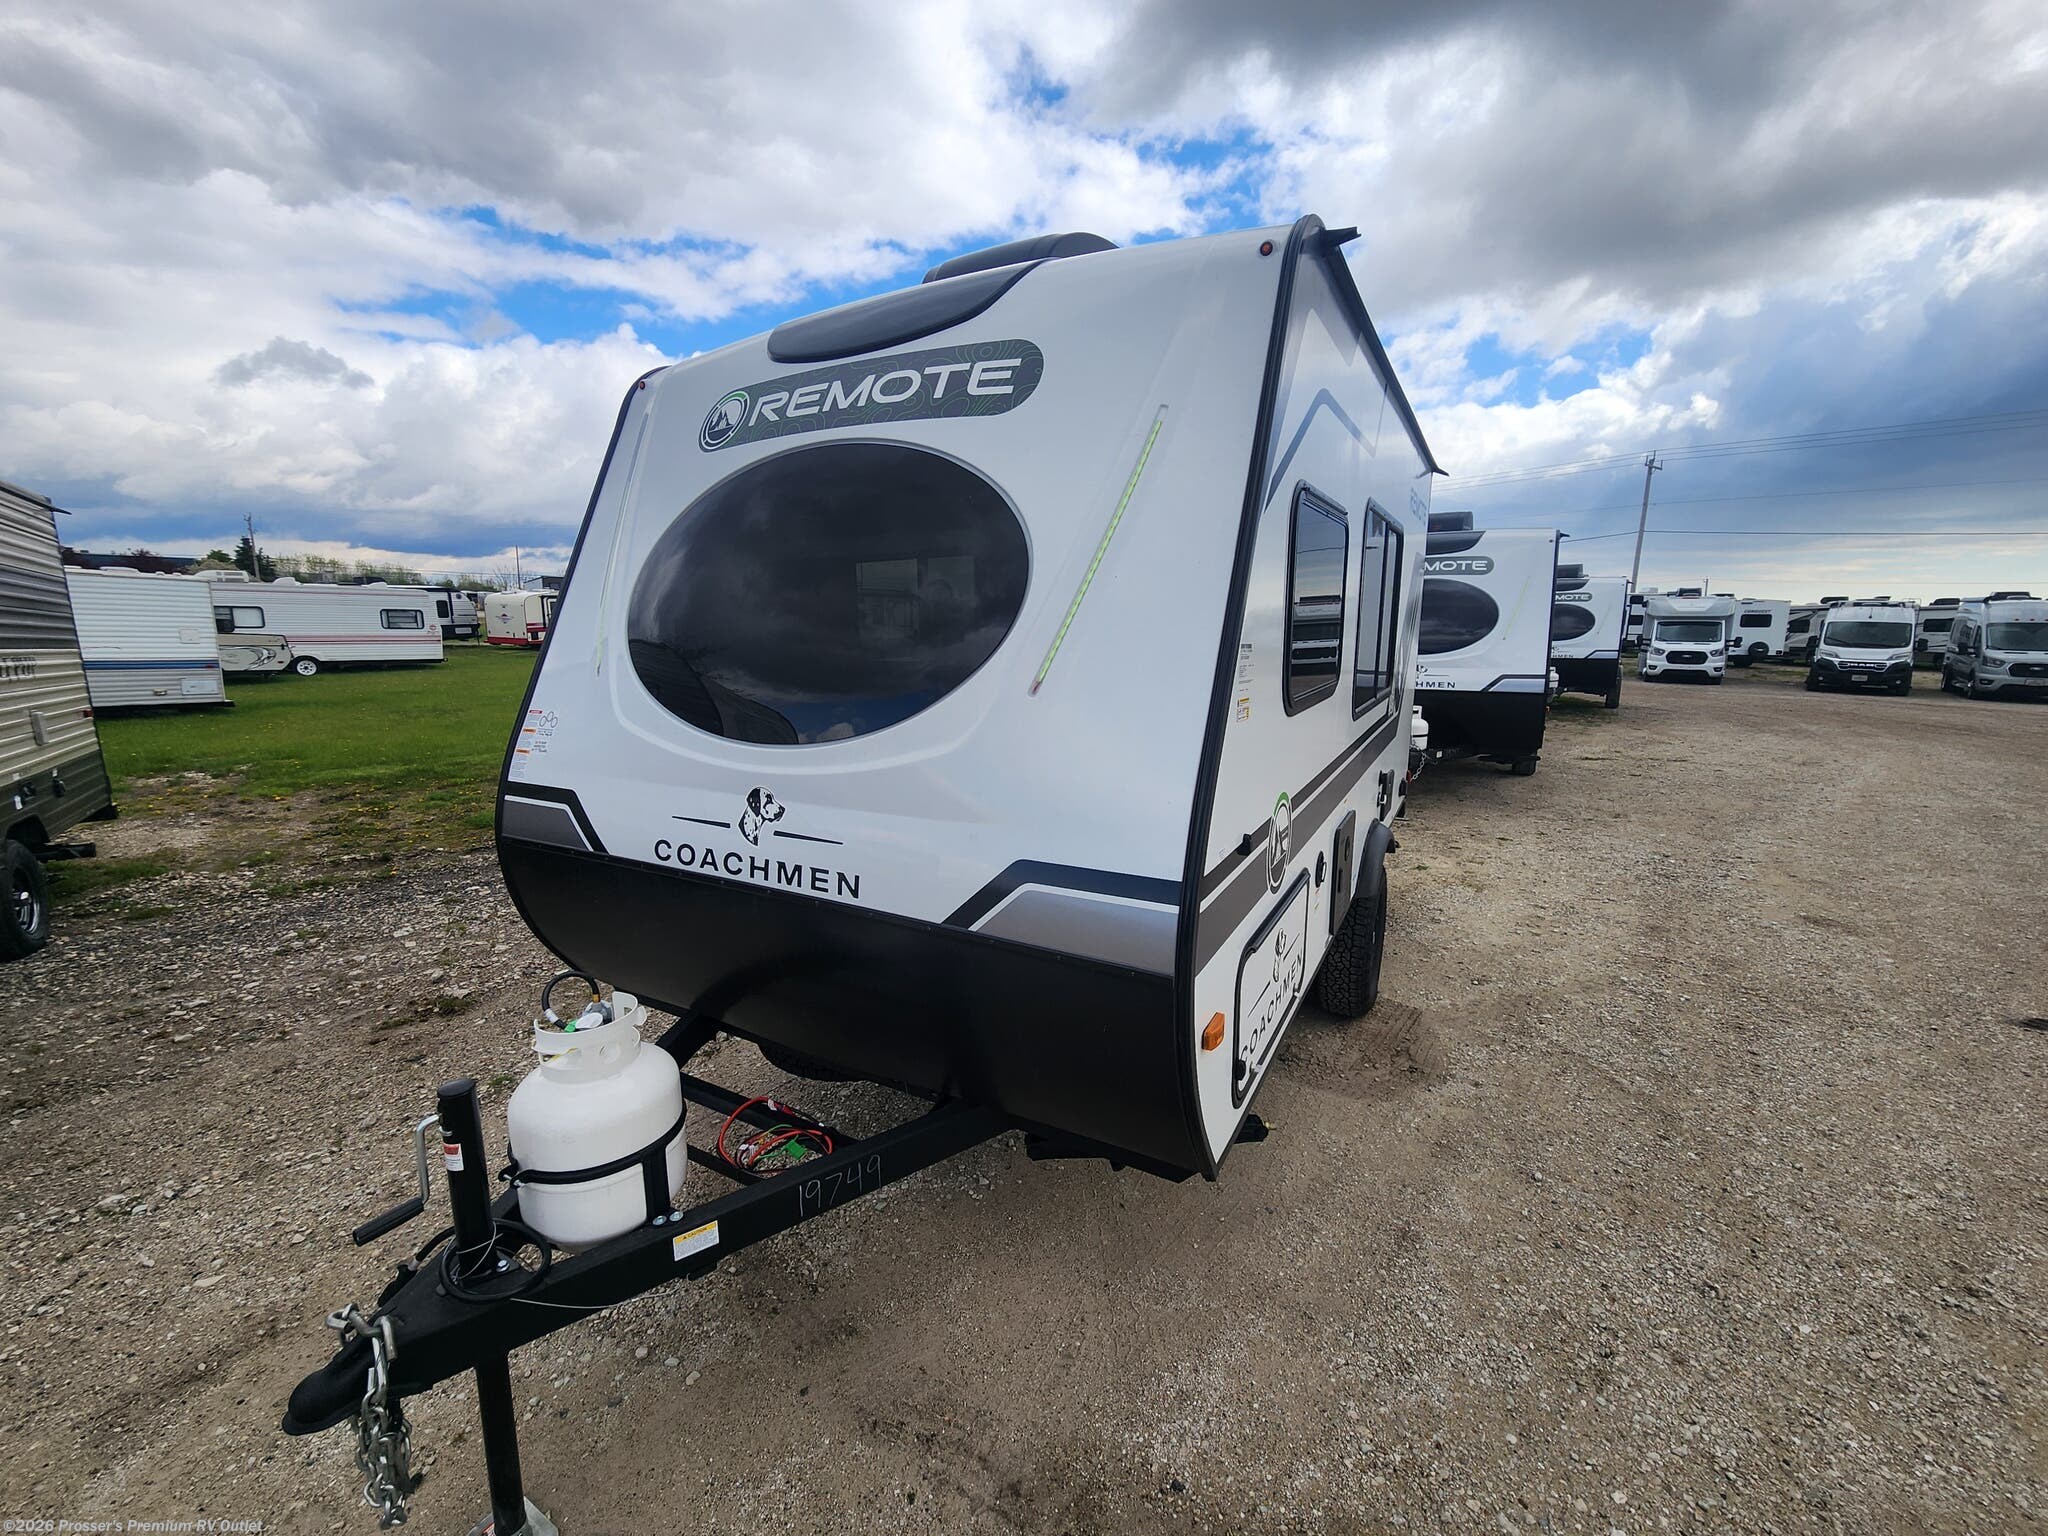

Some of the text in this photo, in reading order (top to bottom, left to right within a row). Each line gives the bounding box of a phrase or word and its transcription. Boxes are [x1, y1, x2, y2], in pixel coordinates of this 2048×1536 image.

[748, 358, 1022, 427] REMOTE
[654, 839, 861, 899] COACHMEN
[1239, 951, 1303, 1063] COACHMEN
[799, 1154, 881, 1218] 19749
